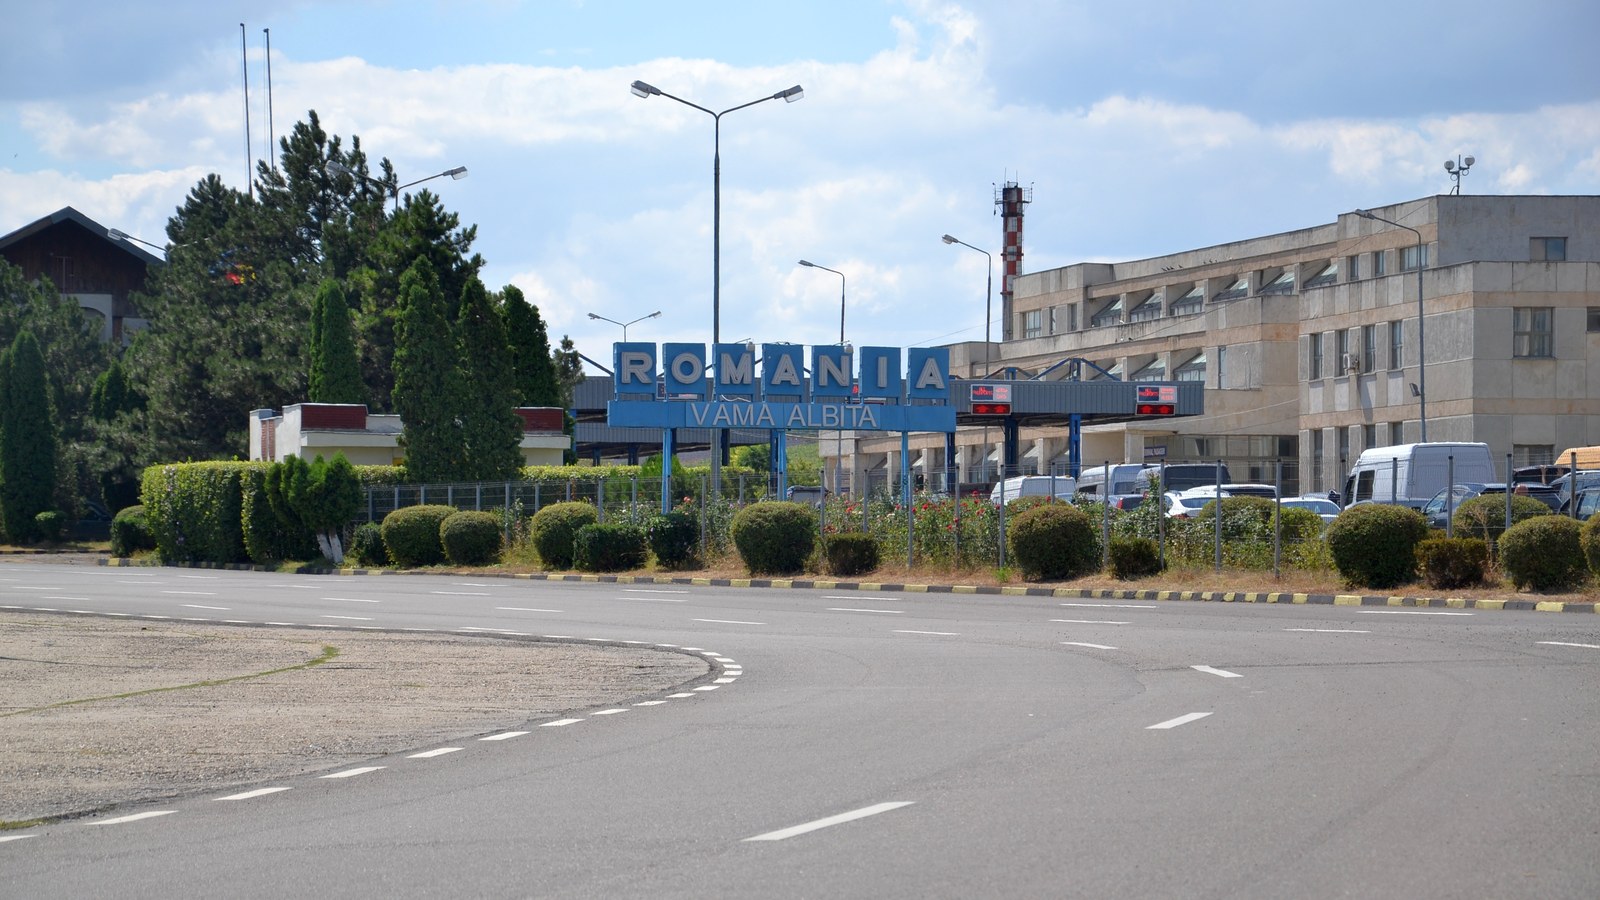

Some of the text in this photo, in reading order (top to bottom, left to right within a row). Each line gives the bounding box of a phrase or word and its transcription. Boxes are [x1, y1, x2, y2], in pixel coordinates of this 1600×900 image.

[621, 351, 946, 389] ROMANIA
[690, 403, 878, 428] VAMA ALBITA
